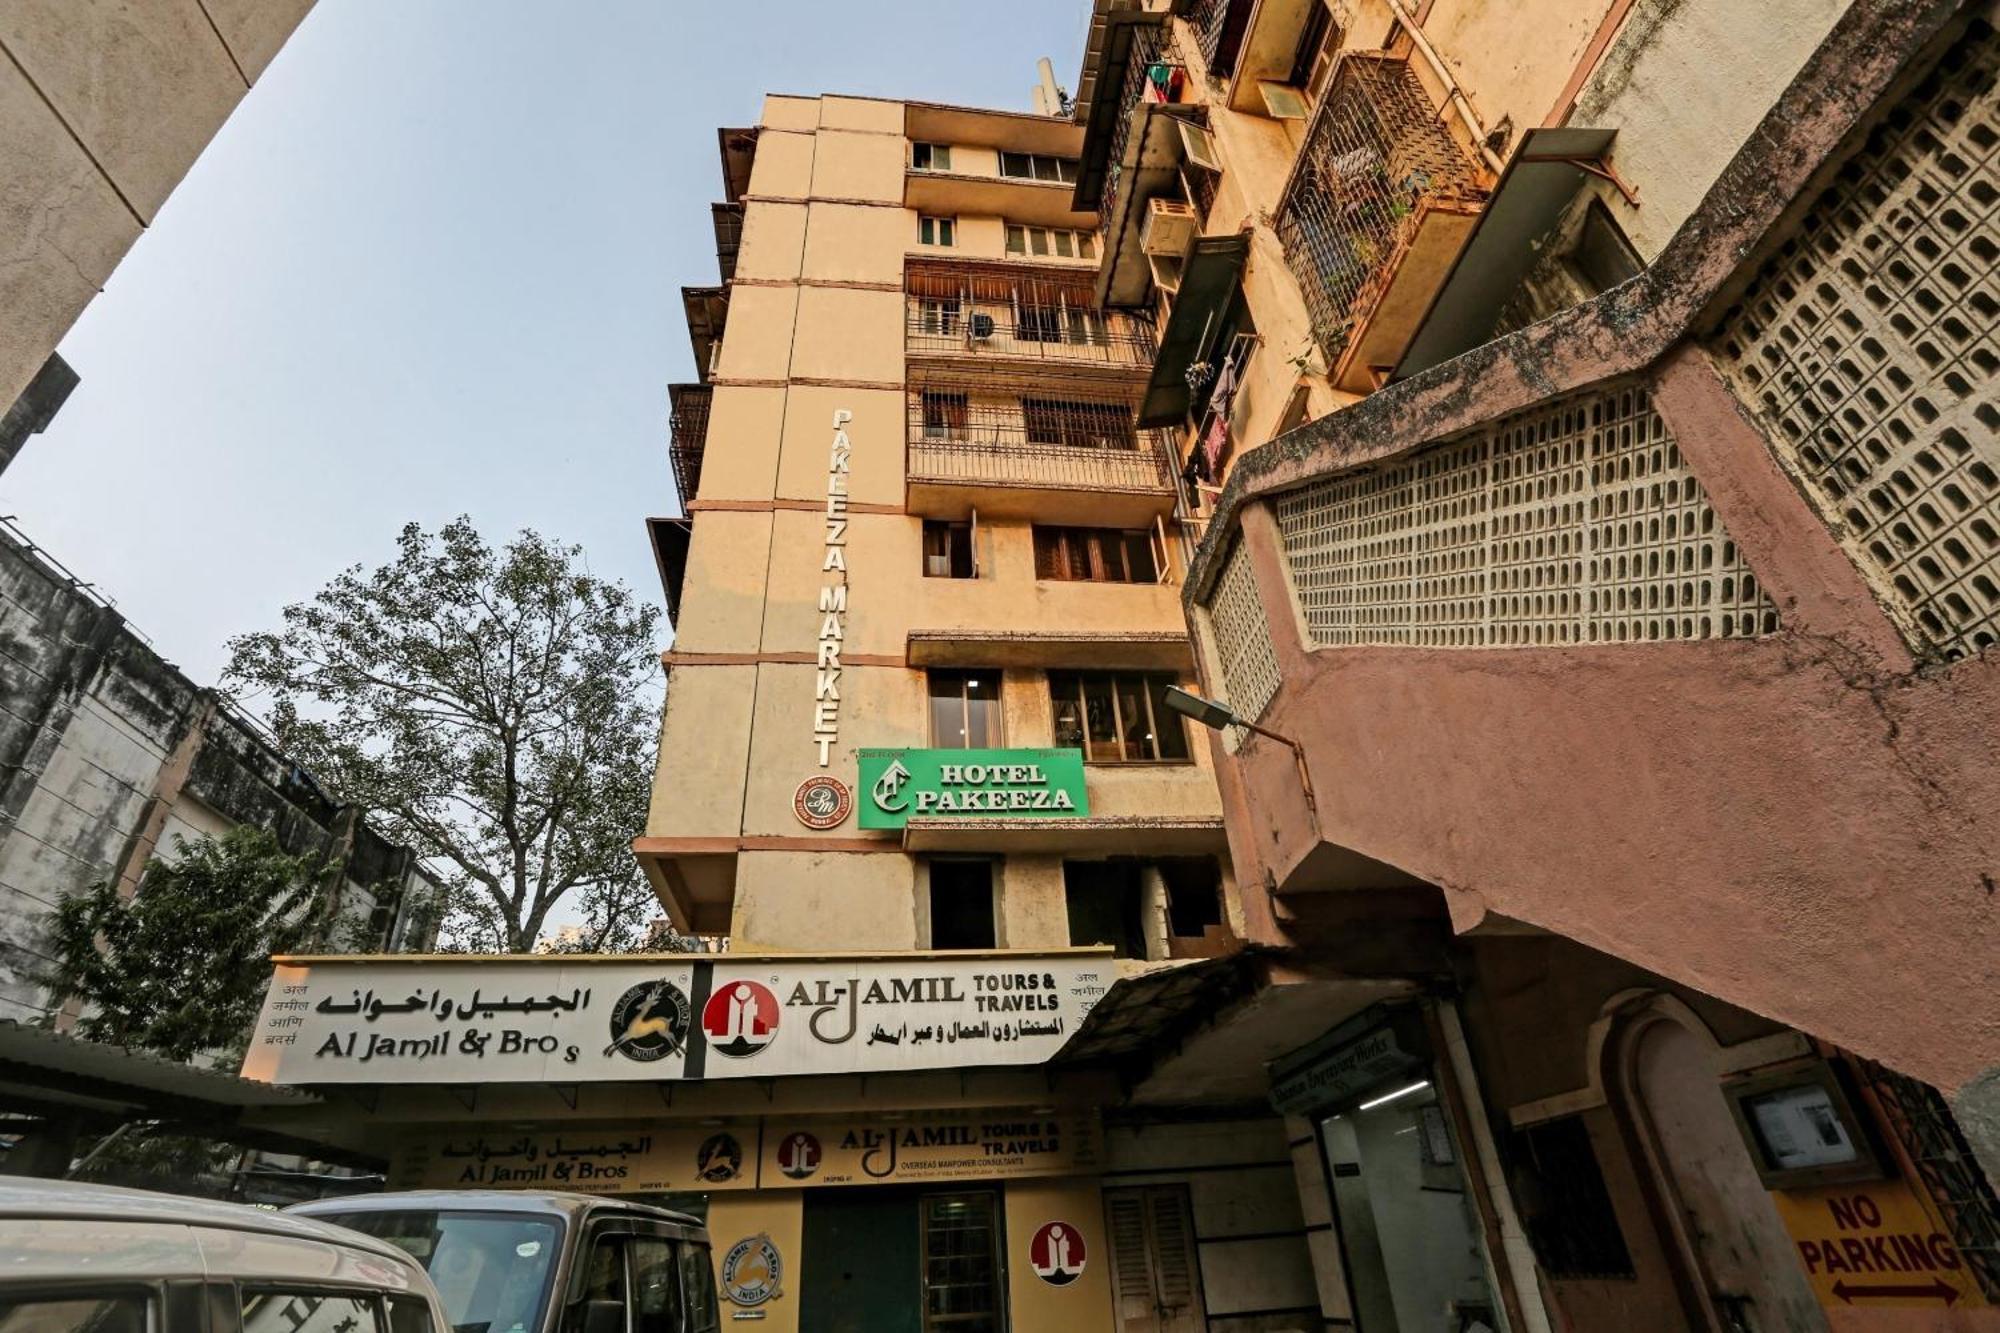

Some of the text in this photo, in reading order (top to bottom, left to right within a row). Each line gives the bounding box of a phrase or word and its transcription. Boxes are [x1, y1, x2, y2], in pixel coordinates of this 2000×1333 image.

[823, 409, 852, 572] PAKEEZA
[814, 586, 848, 767] MARKET
[940, 764, 1047, 785] HOTEL
[915, 788, 1075, 813] PAKEEZA
[972, 972, 1056, 991] TOURS &
[456, 987, 591, 1021] الجميل
[786, 976, 965, 1044] AL-JAMIL
[974, 991, 1059, 1012] TRAVELS
[314, 1031, 355, 1059] Al
[360, 1030, 451, 1061] Jamil
[458, 1029, 492, 1056] &
[631, 1048, 660, 1058] INDIA
[981, 1122, 1061, 1138] TOURS &
[840, 1126, 978, 1178] AL-JAMIL
[982, 1141, 1059, 1156] TRAVELS
[458, 1162, 628, 1185] Al Jamil & Bros
[901, 1159, 937, 1170] OVERSEAS
[1825, 1194, 1882, 1231] NO
[725, 1243, 749, 1282] AL-JAMIL
[1797, 1231, 1962, 1275] PARKING
[738, 1288, 766, 1301] INDIA
